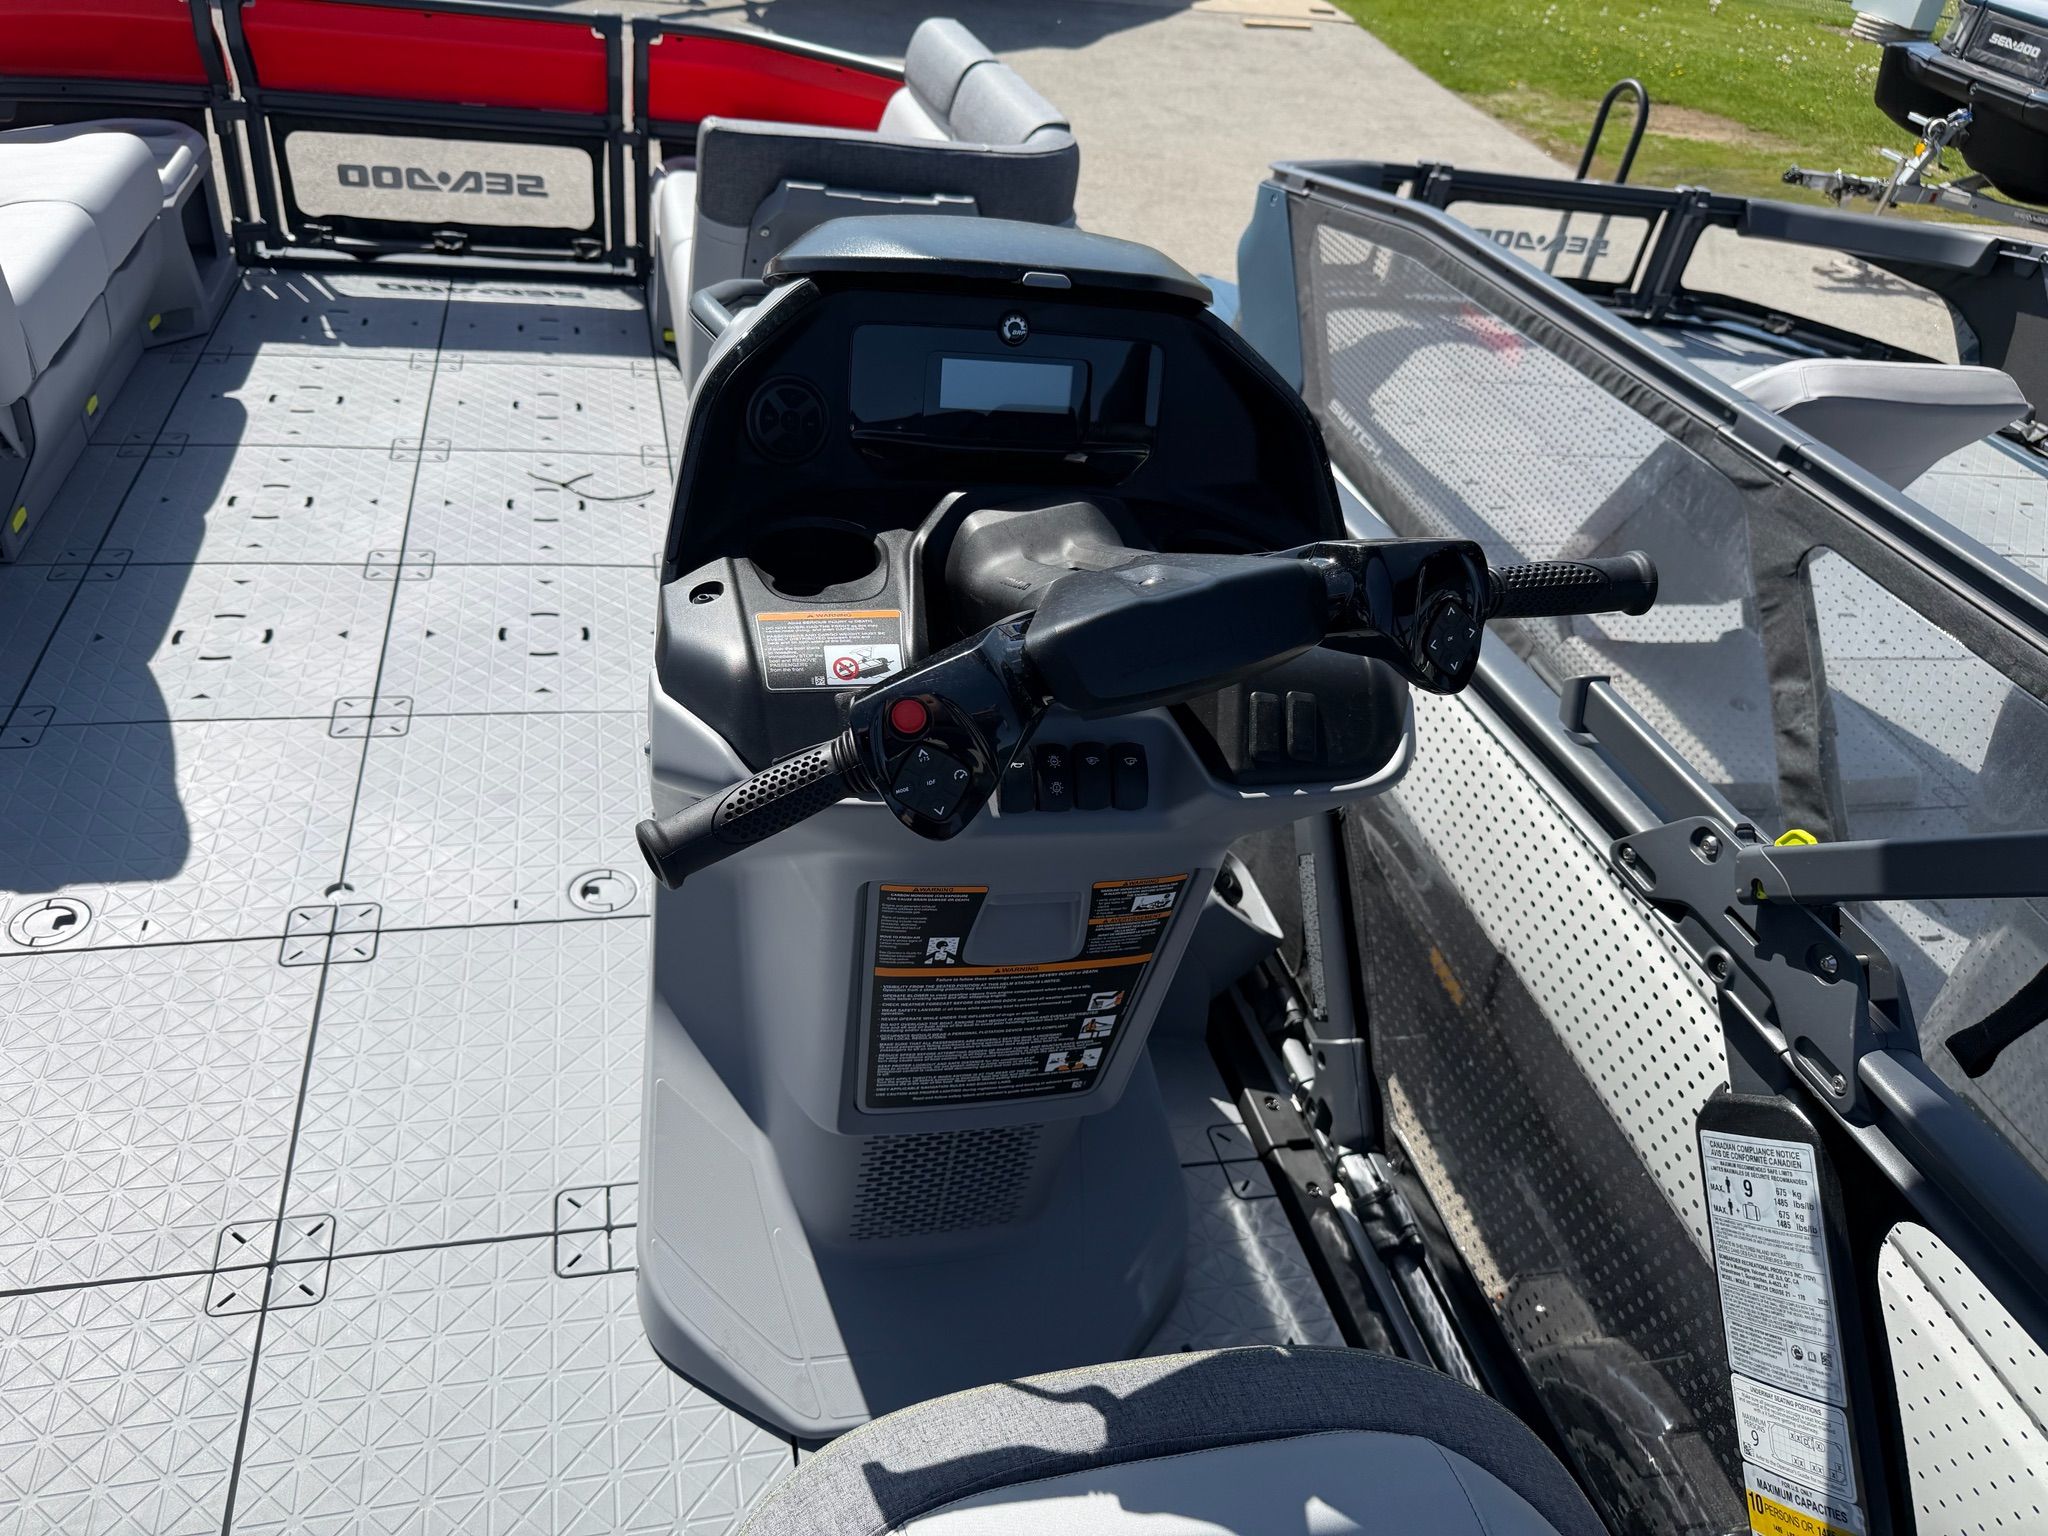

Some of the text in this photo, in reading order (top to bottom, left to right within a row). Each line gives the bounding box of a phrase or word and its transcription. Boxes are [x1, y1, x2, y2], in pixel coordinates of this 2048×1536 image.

[1328, 399, 1382, 458] SWITCH
[1709, 1140, 1800, 1160] CANADIAN COMPLIANCE NOTICE
[1710, 1148, 1721, 1157] AVIS
[1768, 1157, 1802, 1168] CANADIEN
[1710, 1182, 1725, 1192] MAX.
[1743, 1178, 1753, 1197] 9
[1776, 1187, 1802, 1200] 675 kg
[1713, 1204, 1728, 1214] MAX.
[1774, 1197, 1814, 1211] 1485 lbs/lb
[1779, 1210, 1805, 1223] 675 kg
[1777, 1219, 1818, 1234] 1485 lbs/lb
[1742, 1259, 1769, 1271] RECREATIONAL
[1770, 1266, 1793, 1276] PRODUCTS
[1754, 1282, 1768, 1290] SWITCH
[1769, 1286, 1784, 1295] CRUISE
[1774, 1394, 1793, 1406] SEATING
[1795, 1401, 1822, 1416] POSITIONS
[1742, 1411, 1766, 1427] MAXIMUM
[1744, 1419, 1765, 1433] PERSONS
[1751, 1428, 1760, 1448] 9
[1781, 1480, 1790, 1488] FOR
[1800, 1486, 1813, 1498] ONLY
[1756, 1478, 1848, 1523] MAXIMUM CAPACITIES
[1749, 1492, 1764, 1515] 10
[1764, 1504, 1800, 1529] PERSONS
[1801, 1521, 1815, 1534] OR
